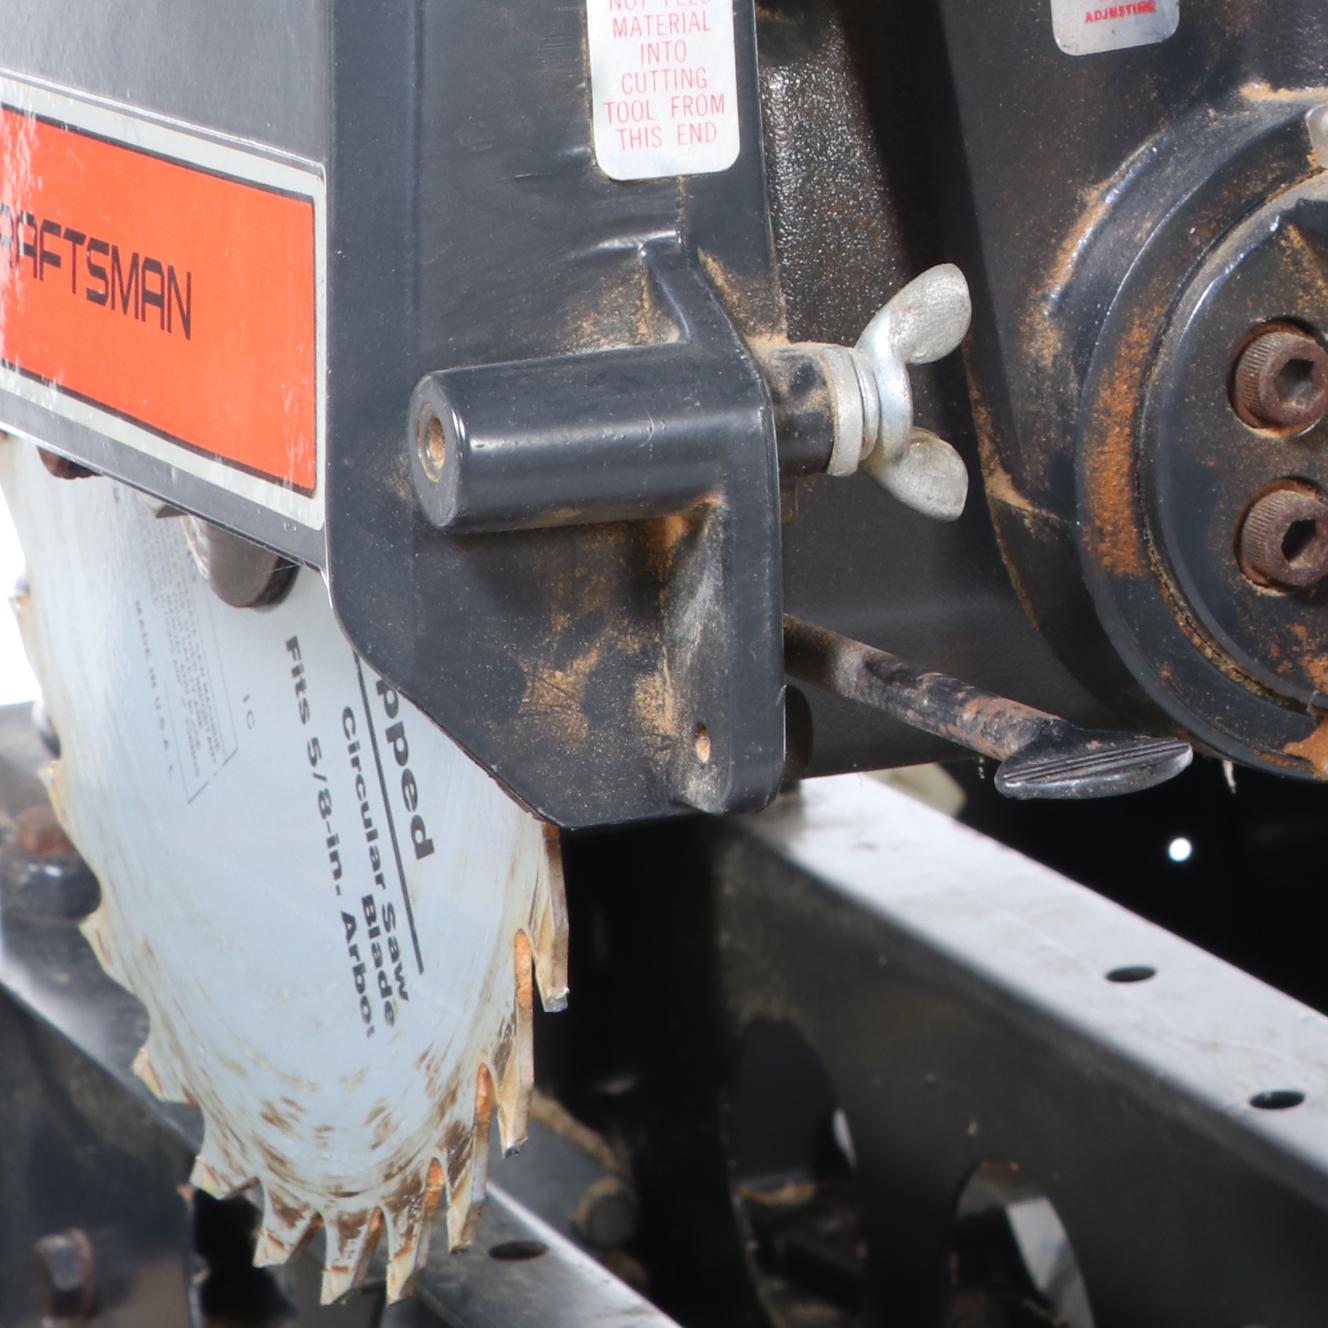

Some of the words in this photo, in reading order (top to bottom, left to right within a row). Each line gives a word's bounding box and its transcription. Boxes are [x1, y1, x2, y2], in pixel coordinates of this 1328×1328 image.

[612, 9, 712, 40] MATERIAL
[1085, 0, 1157, 24] ADJUSTING
[640, 39, 688, 65] INTO
[620, 67, 708, 95] CUTTING
[603, 99, 656, 124] TOOL
[671, 93, 726, 119] FROM
[615, 126, 663, 151] THIS
[677, 120, 718, 146] END
[286, 635, 310, 725] Fits
[342, 706, 386, 890] Circular
[382, 901, 410, 1001] Saw
[361, 894, 396, 1028] Blade
